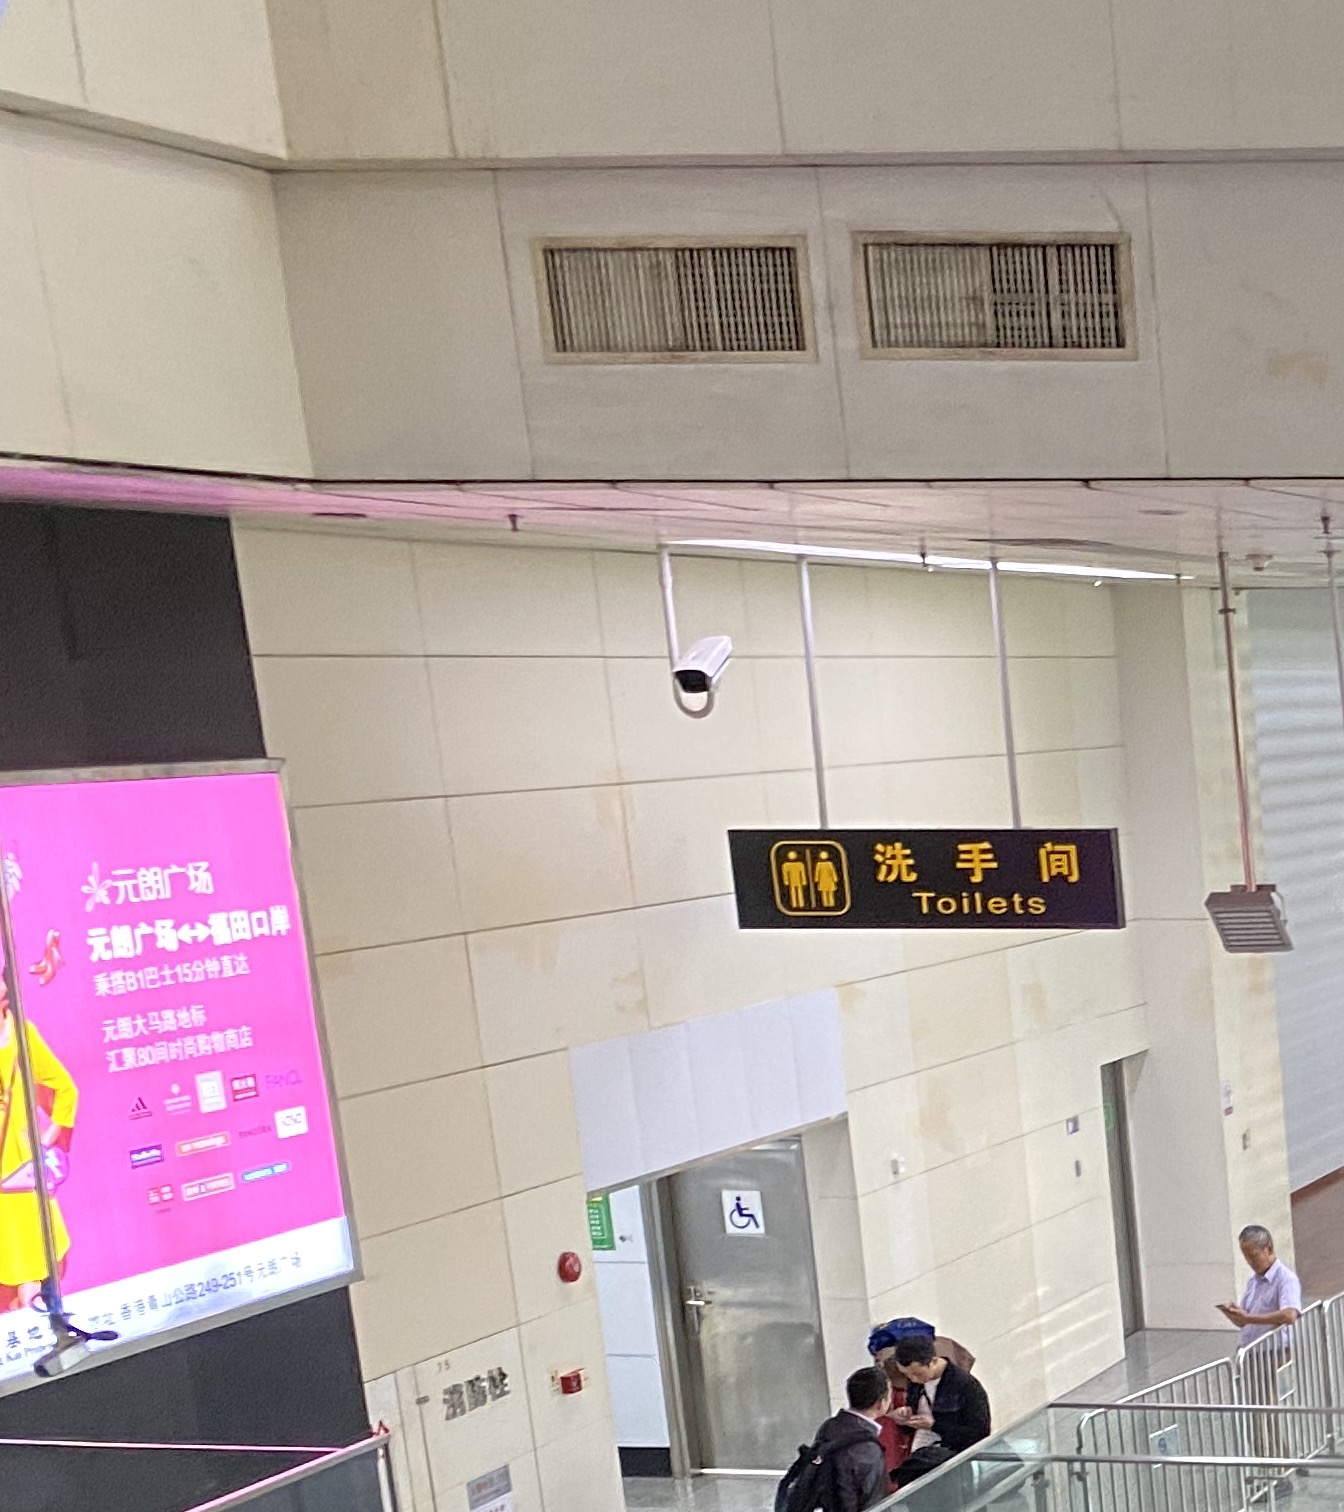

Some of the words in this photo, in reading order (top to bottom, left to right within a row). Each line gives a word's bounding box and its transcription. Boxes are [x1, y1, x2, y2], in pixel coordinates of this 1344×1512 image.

[111, 861, 214, 905] 元朗广场
[873, 841, 1081, 883] 洗手间
[912, 891, 1047, 915] Toilets
